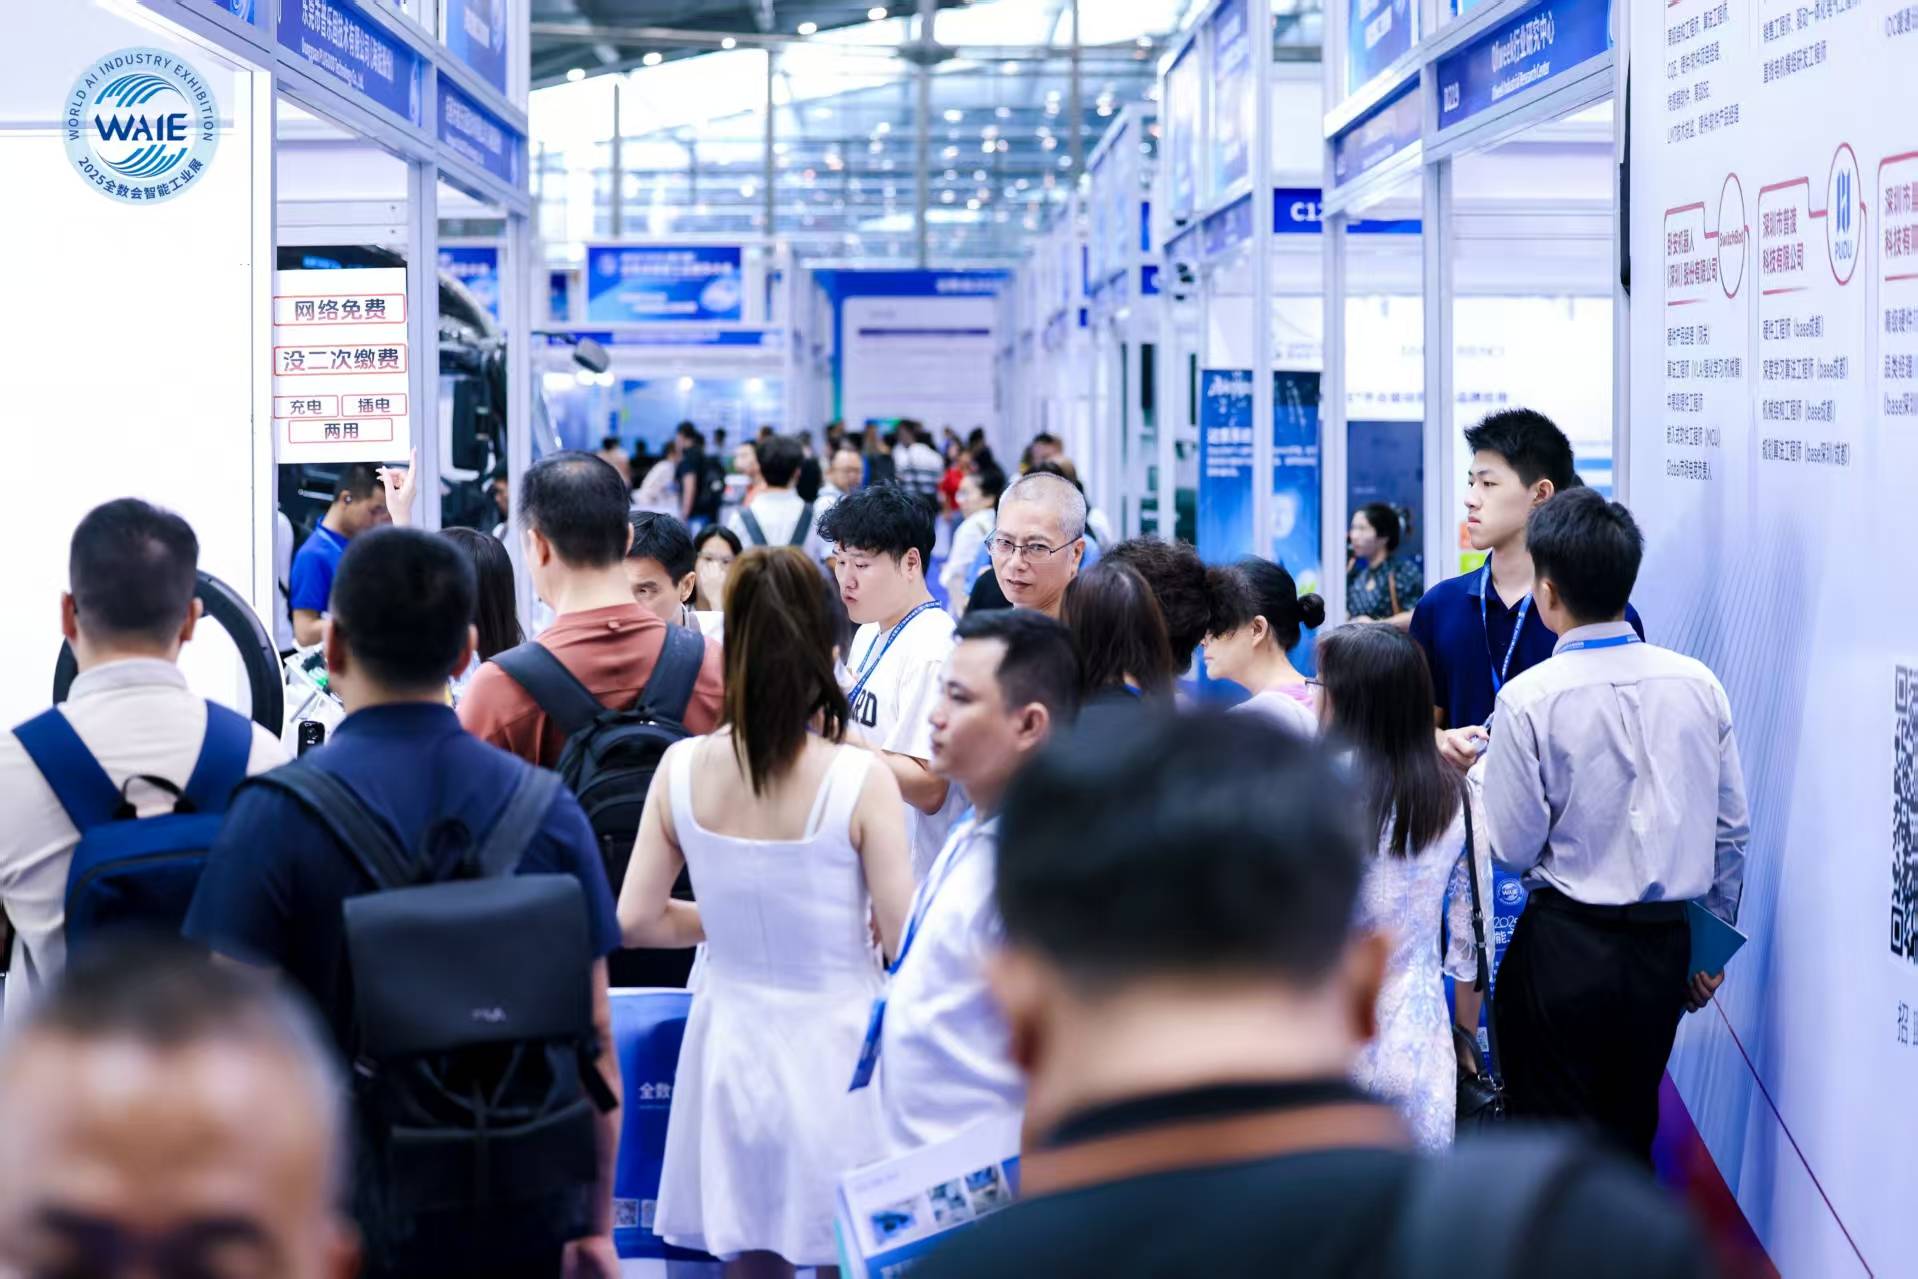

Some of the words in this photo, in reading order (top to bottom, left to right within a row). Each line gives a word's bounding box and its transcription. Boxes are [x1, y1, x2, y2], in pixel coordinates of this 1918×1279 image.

[1719, 229, 1744, 248] SwitchBot
[1763, 242, 1804, 275] 科技有限公司
[1835, 239, 1853, 260] PUDU
[295, 299, 386, 321] 网络免费
[283, 348, 400, 371] 没二次缴费
[290, 400, 322, 415] 充电
[358, 398, 390, 413] 插电
[324, 423, 359, 439] 两用
[638, 1082, 674, 1099] 全数
